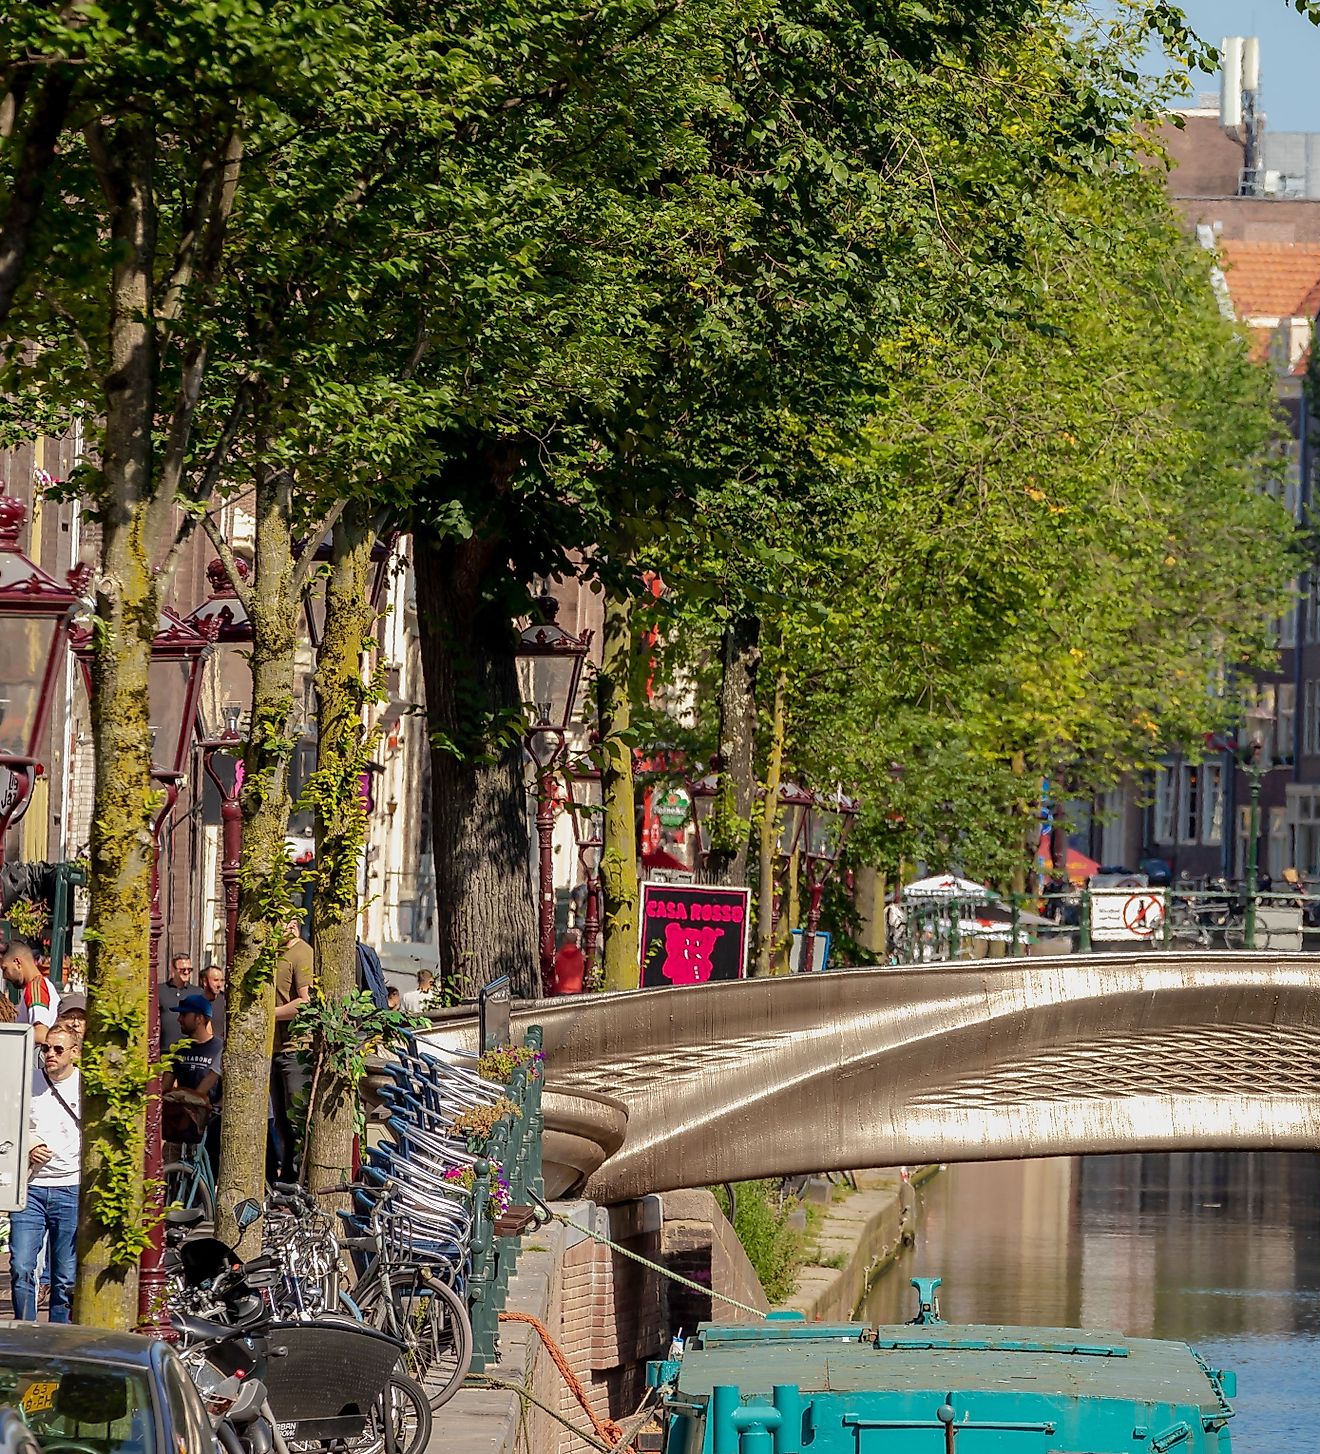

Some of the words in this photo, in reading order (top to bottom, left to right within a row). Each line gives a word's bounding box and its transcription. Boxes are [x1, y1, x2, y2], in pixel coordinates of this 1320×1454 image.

[646, 901, 687, 919] CASA
[690, 903, 744, 922] ROSSO
[33, 1384, 47, 1395] 63
